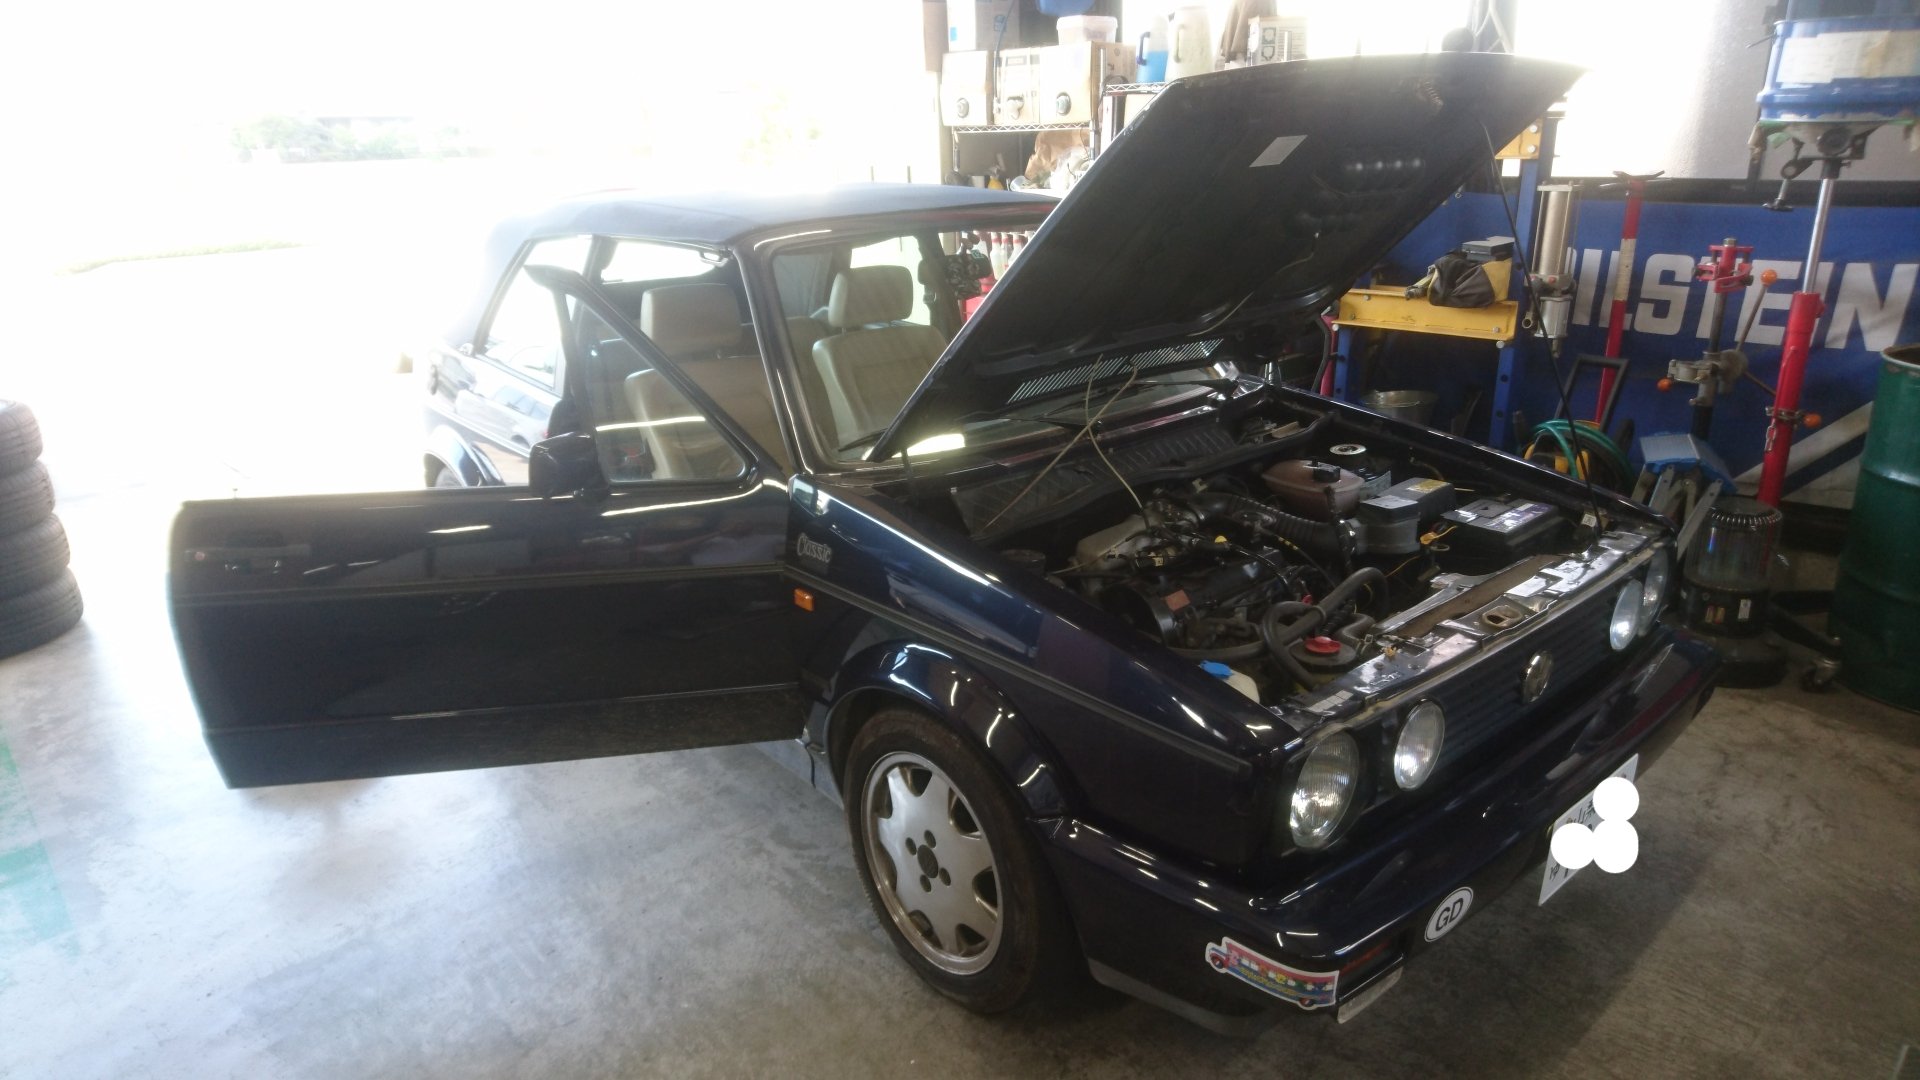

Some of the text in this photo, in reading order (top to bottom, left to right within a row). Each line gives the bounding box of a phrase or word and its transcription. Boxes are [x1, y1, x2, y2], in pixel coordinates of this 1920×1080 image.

[1564, 246, 1919, 352] ILSTEIN
[797, 533, 832, 563] Classic
[1435, 897, 1464, 931] GD
